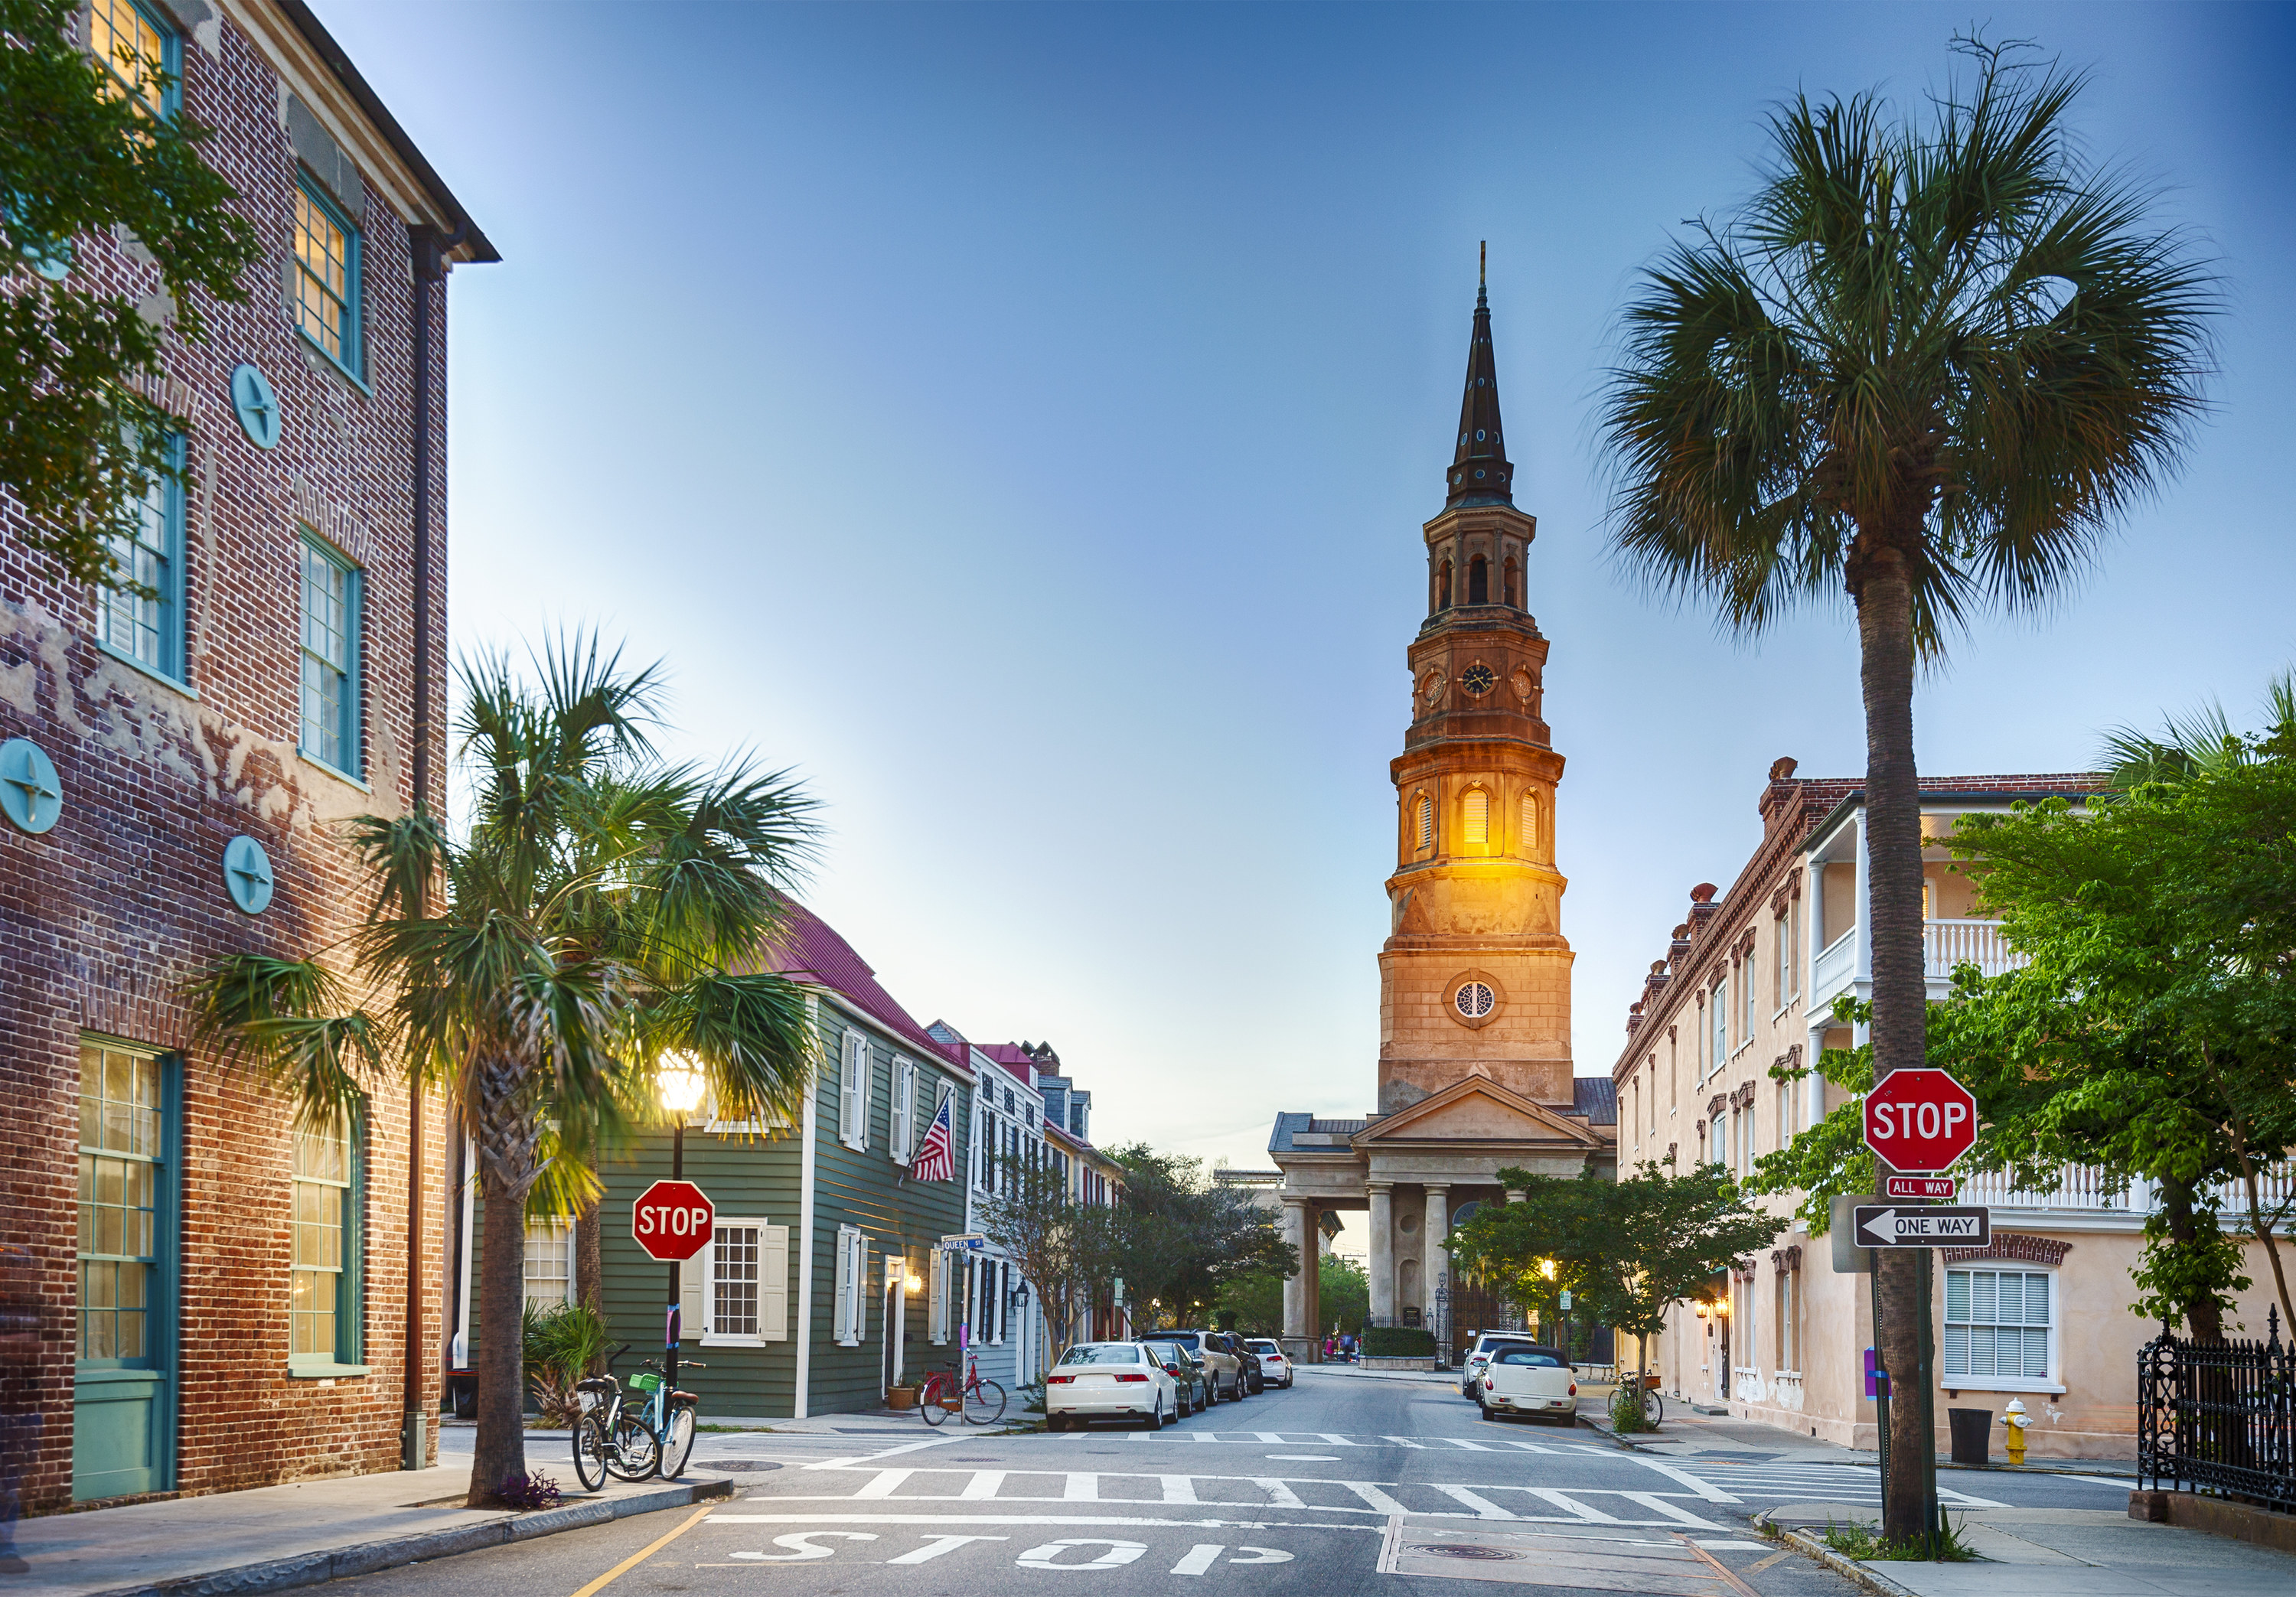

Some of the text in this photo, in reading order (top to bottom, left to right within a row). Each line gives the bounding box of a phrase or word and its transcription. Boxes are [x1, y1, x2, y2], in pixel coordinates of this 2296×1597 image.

[1873, 1102, 1967, 1139] STOP
[1893, 1181, 1949, 1194] ALL WAY
[639, 1205, 709, 1236] STOP
[1895, 1218, 1975, 1234] ONE WAY
[944, 1240, 969, 1250] QUEEN
[727, 1531, 1295, 1576] STOP
